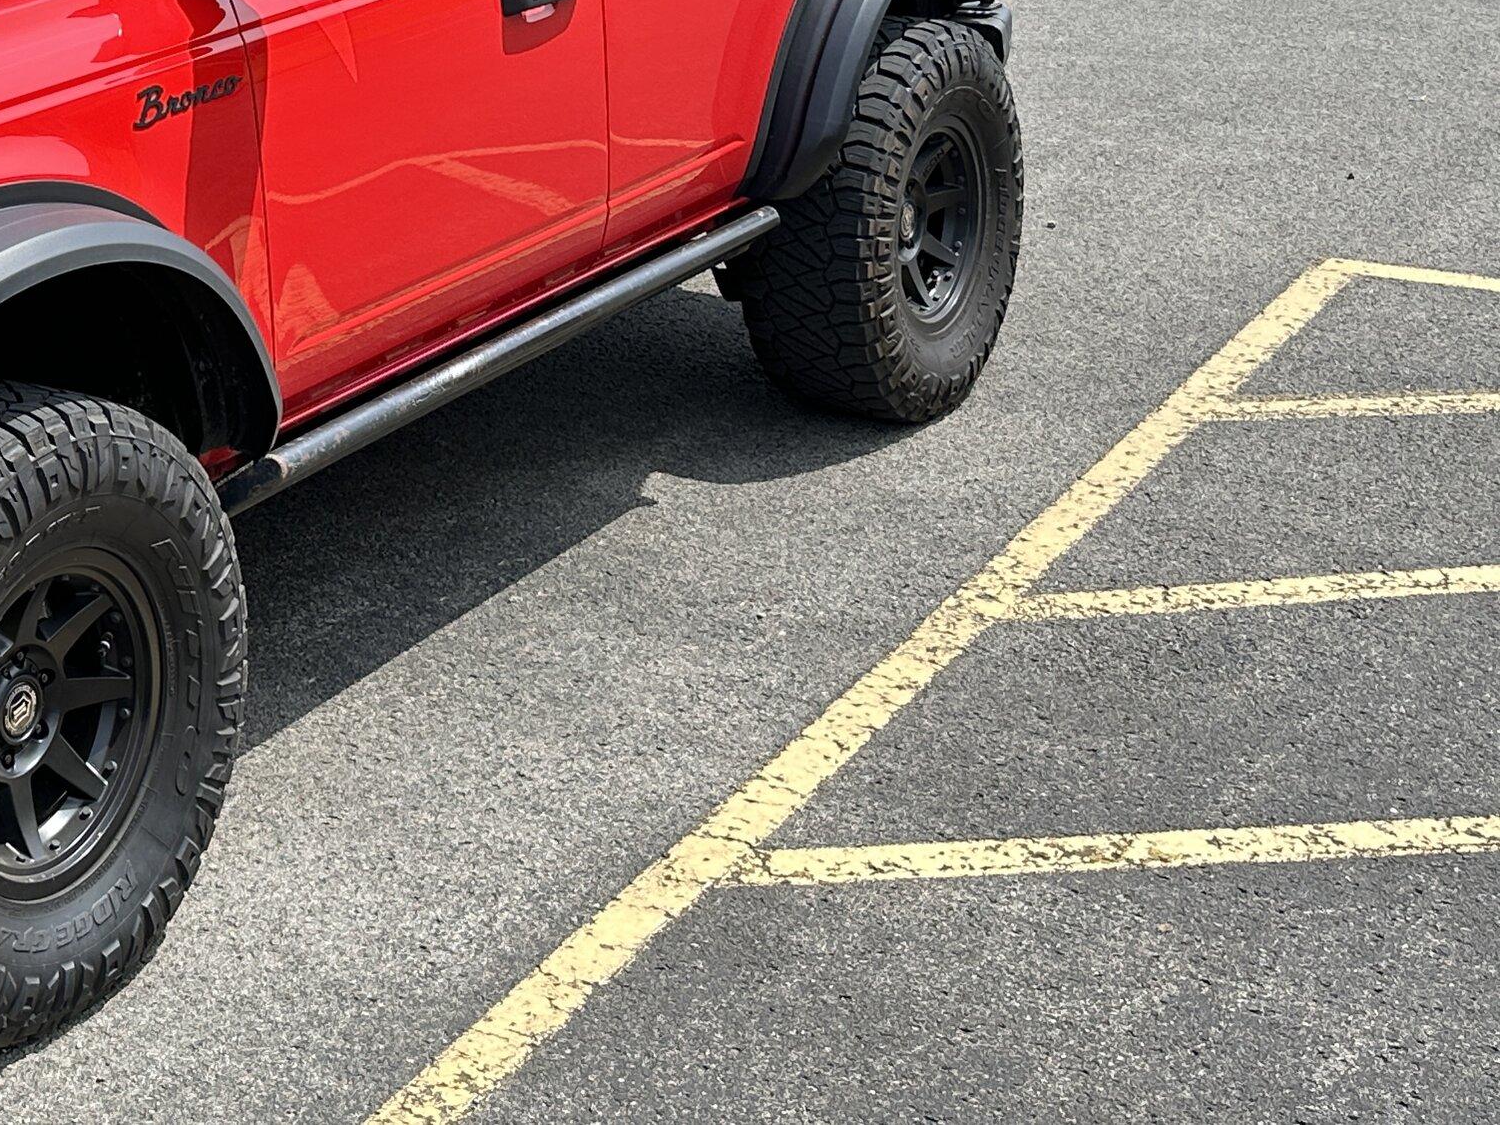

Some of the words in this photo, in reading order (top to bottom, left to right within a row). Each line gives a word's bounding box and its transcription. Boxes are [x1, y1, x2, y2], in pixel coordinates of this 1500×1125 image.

[132, 74, 244, 132] Bronco
[150, 536, 203, 797] NITTO
[55, 858, 141, 950] RIDGE
